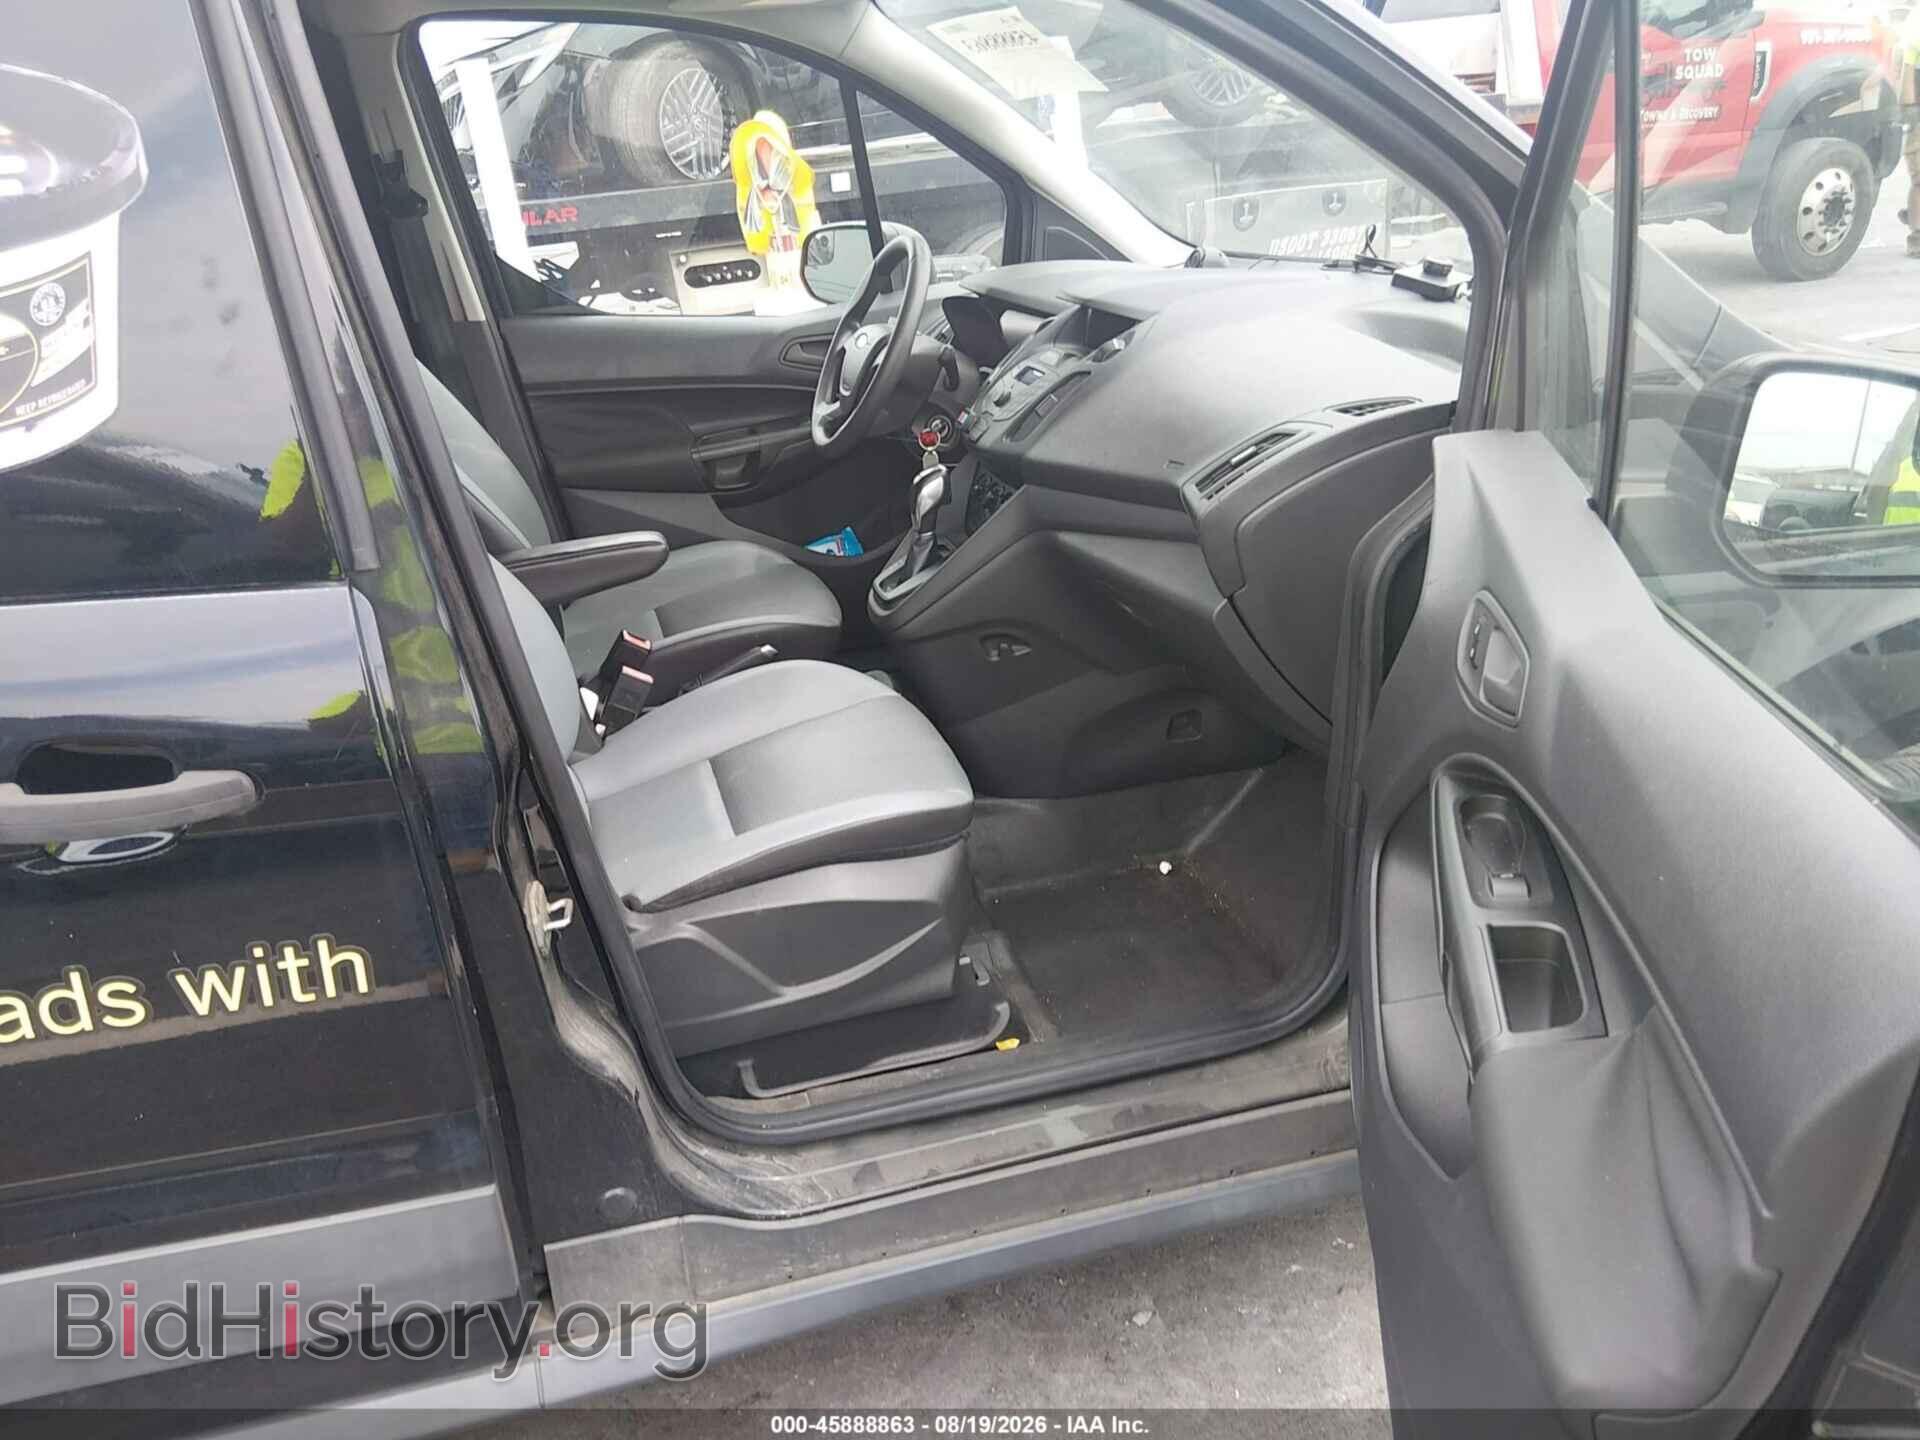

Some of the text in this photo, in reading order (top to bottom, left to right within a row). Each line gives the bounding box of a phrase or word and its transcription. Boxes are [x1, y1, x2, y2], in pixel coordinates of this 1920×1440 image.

[1684, 47, 1717, 63] TOW
[1674, 64, 1725, 80] SQUAD
[172, 936, 372, 1017] with
